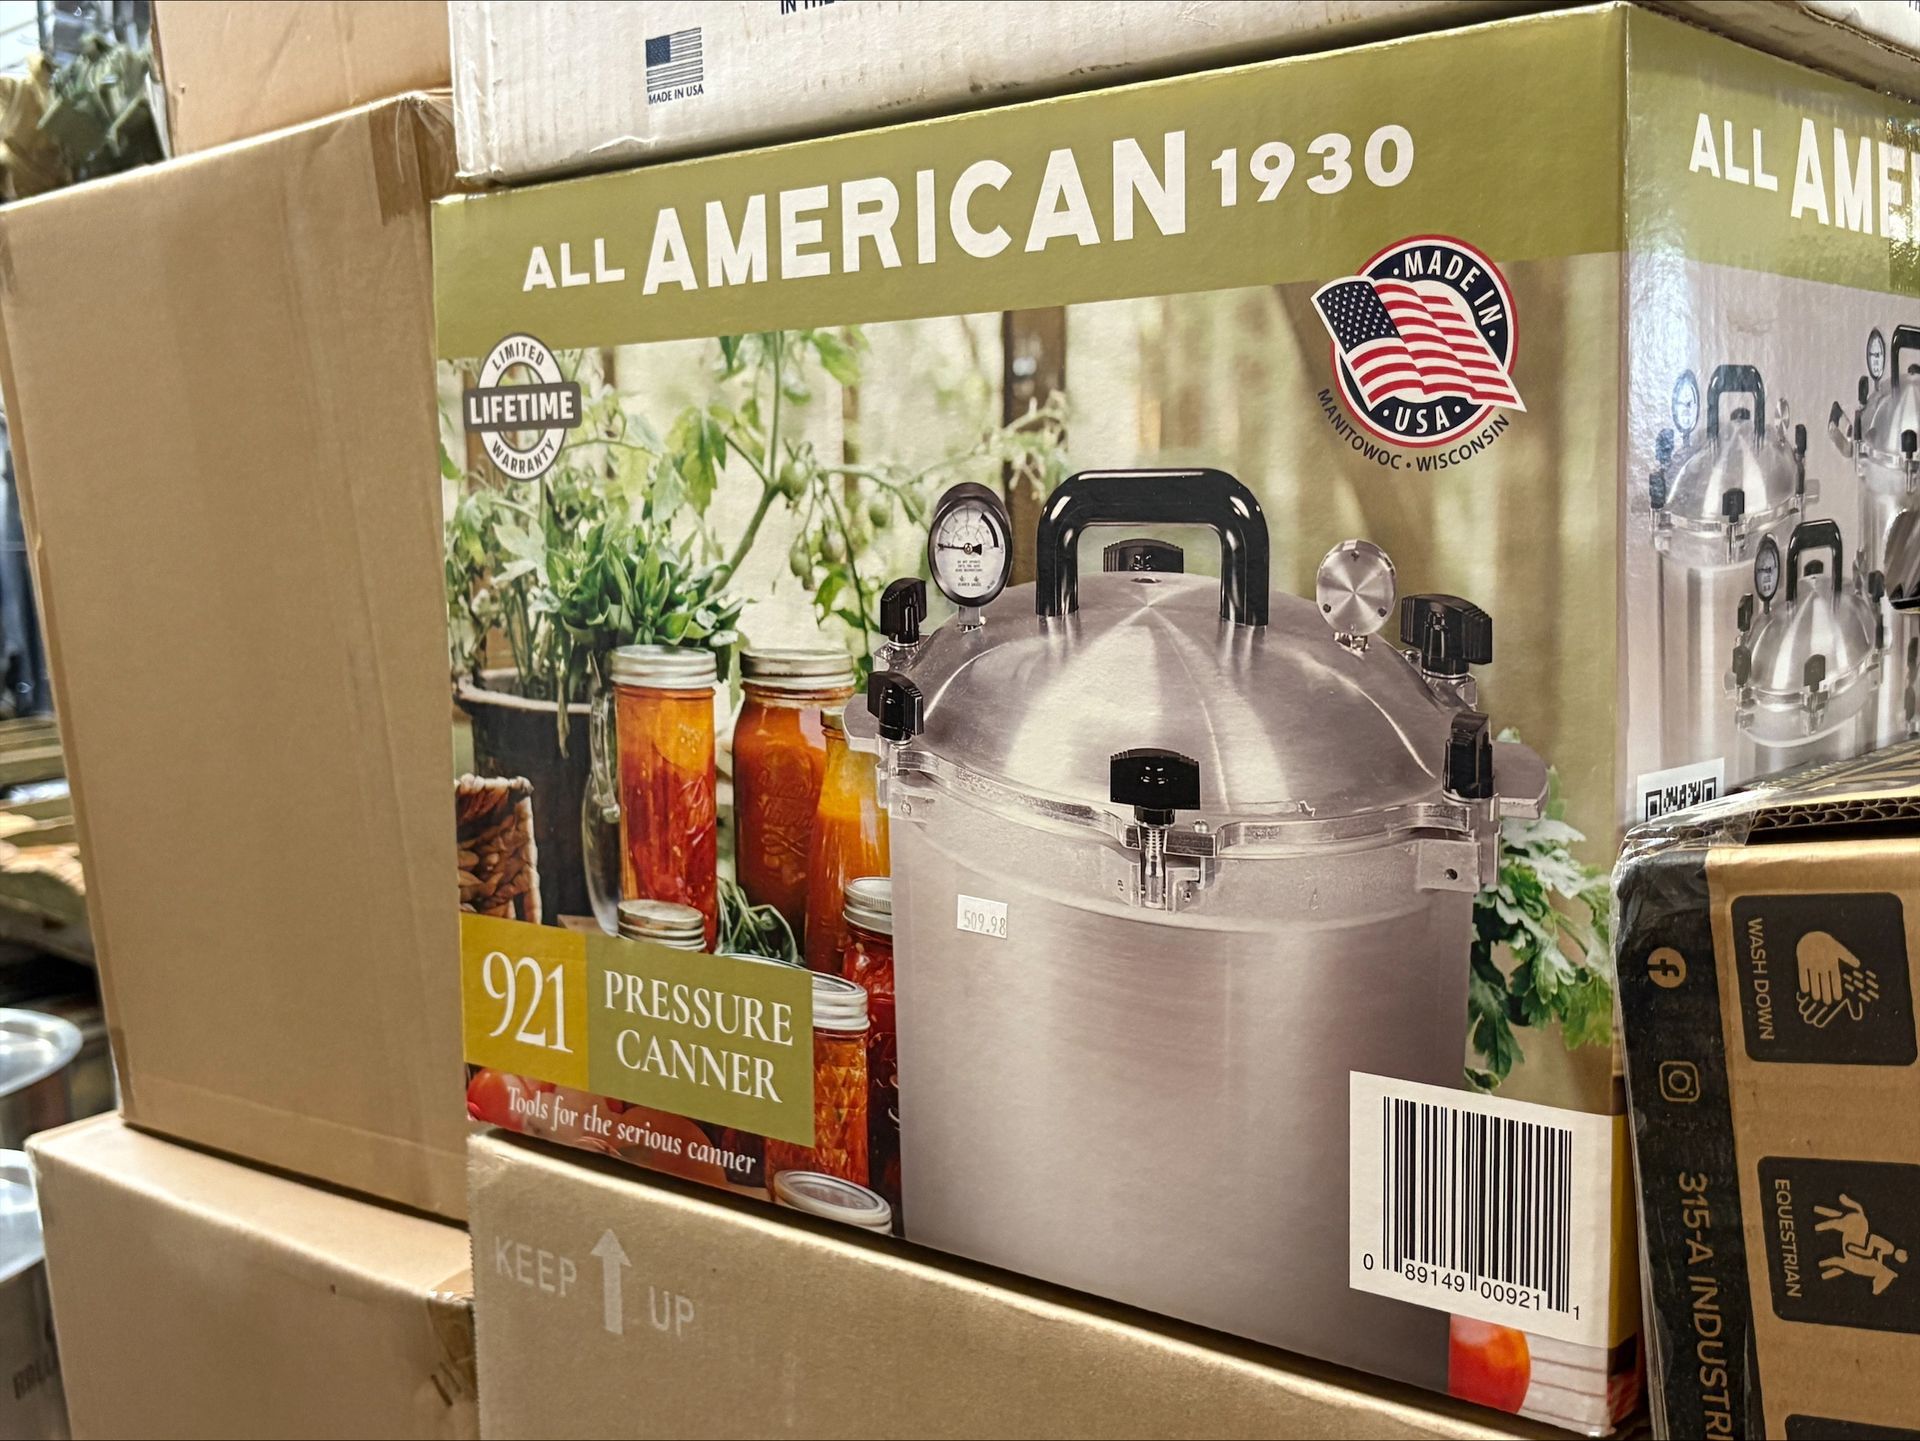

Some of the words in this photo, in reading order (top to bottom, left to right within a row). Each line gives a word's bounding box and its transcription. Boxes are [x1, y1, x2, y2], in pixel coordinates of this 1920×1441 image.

[648, 90, 673, 105] MADE
[674, 87, 684, 99] IN
[686, 84, 704, 97] USA
[522, 238, 625, 292] ALL
[642, 130, 1186, 296] AMERICAN
[1211, 124, 1414, 208] 1930
[1688, 113, 1778, 192] ALL
[1790, 117, 1920, 246] AME
[1404, 249, 1481, 293] MADE
[1473, 288, 1504, 328] IN
[491, 342, 545, 372] LIMITED
[469, 391, 574, 425] LIFETIME
[1317, 387, 1402, 471] MANITOWOC
[1415, 414, 1510, 472] WISCONSIN
[1394, 404, 1451, 434] USA
[492, 437, 555, 474] WARRANTY
[963, 909, 1006, 936] 509.98
[1746, 917, 1769, 974] WASH
[482, 950, 574, 1055] 921
[603, 969, 794, 1047] PRESSURE
[1752, 979, 1775, 1040] DOWN
[616, 1028, 783, 1105] CANNER
[506, 1084, 549, 1122] Tools
[550, 1094, 579, 1132] for
[583, 1105, 612, 1137] the
[616, 1121, 683, 1156] serious
[687, 1141, 757, 1175] canner
[1678, 1171, 1715, 1266] 315-A
[1775, 1179, 1802, 1297] EQUESTRIAN
[495, 1236, 578, 1298] KEEP
[1363, 1253, 1374, 1271] 0
[1404, 1263, 1466, 1293] 89149
[1480, 1281, 1542, 1312] 00921
[1572, 1305, 1581, 1322] 1
[649, 1285, 696, 1338] UP
